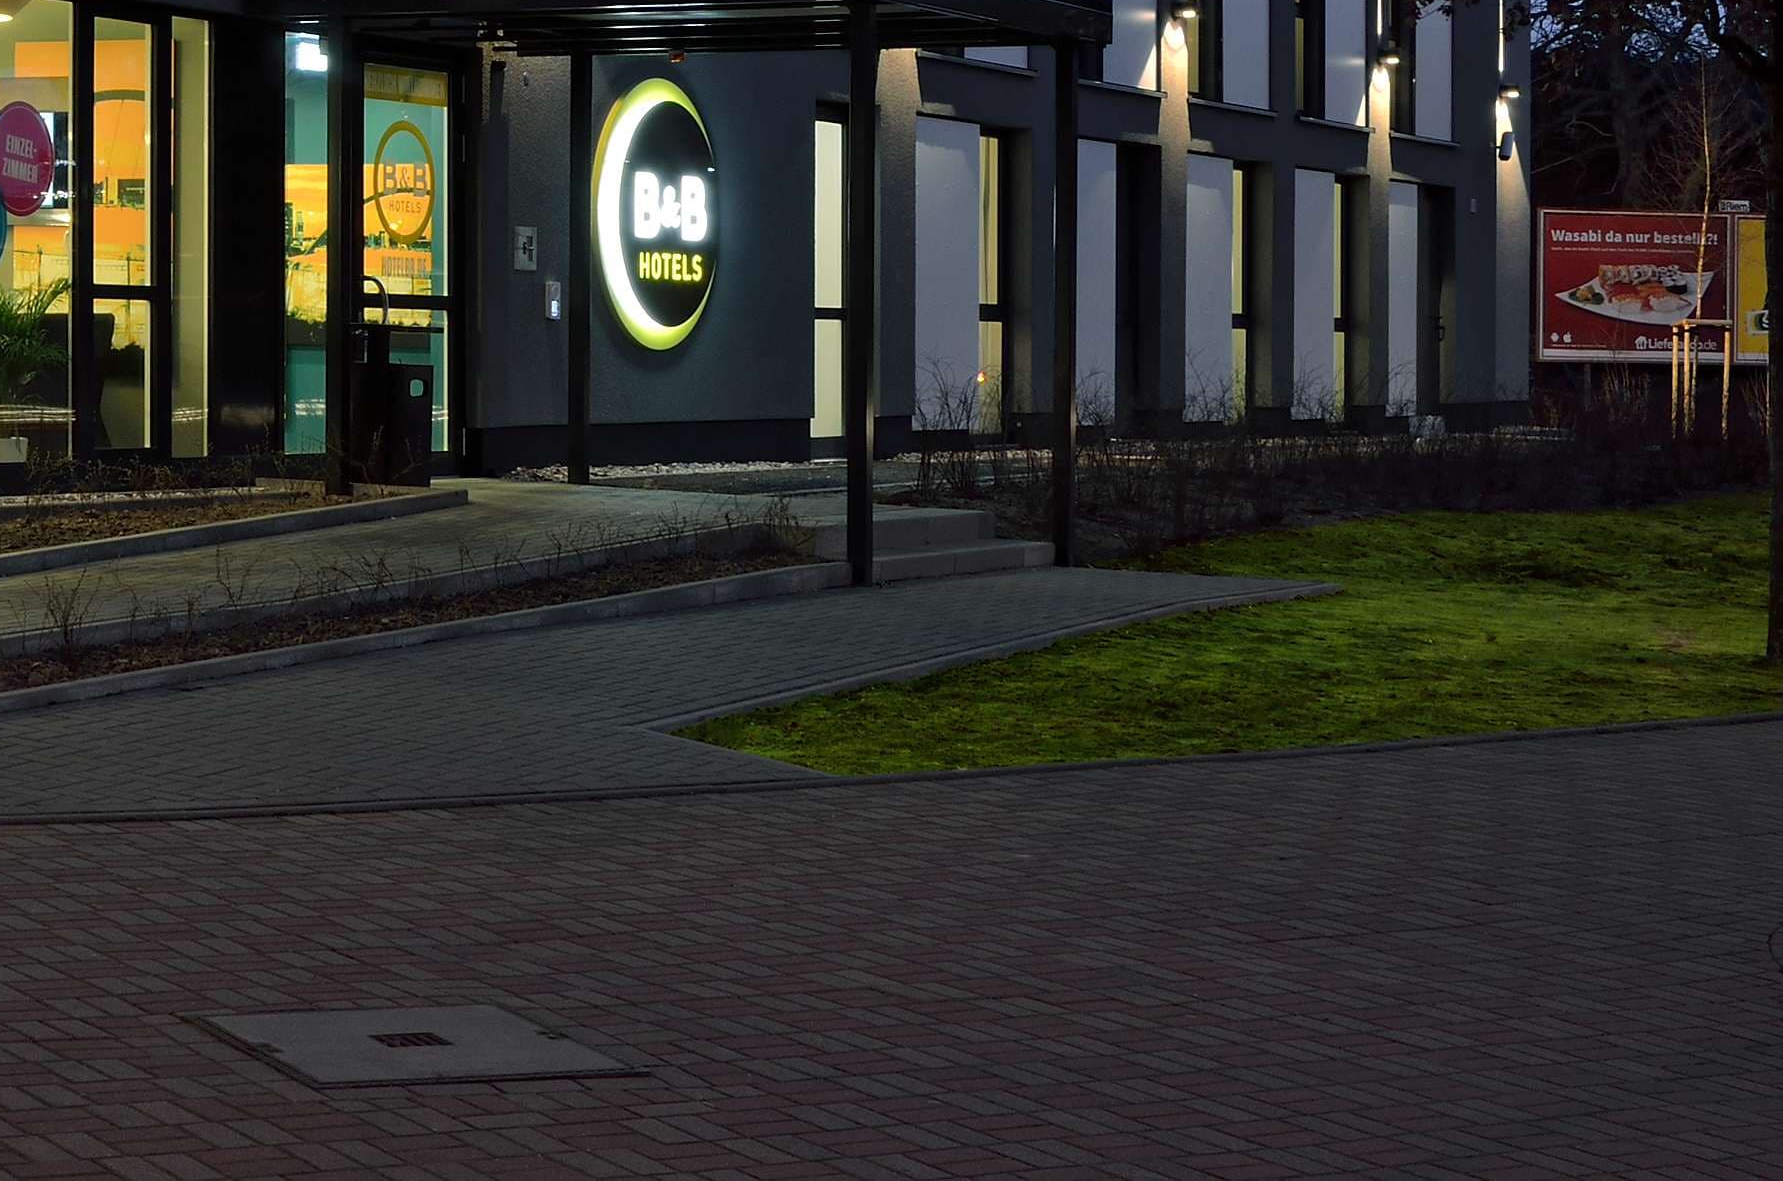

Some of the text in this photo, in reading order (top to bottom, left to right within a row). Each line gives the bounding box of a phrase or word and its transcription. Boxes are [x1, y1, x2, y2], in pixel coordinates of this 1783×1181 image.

[5, 133, 38, 160] EINZEL-
[2, 157, 40, 184] ZIMMER
[383, 160, 429, 198] B&B
[388, 199, 423, 214] HOTELS
[633, 170, 709, 243] B&B
[1551, 229, 1719, 247] Wasabi da nur bestell?!
[638, 250, 704, 282] HOTELS
